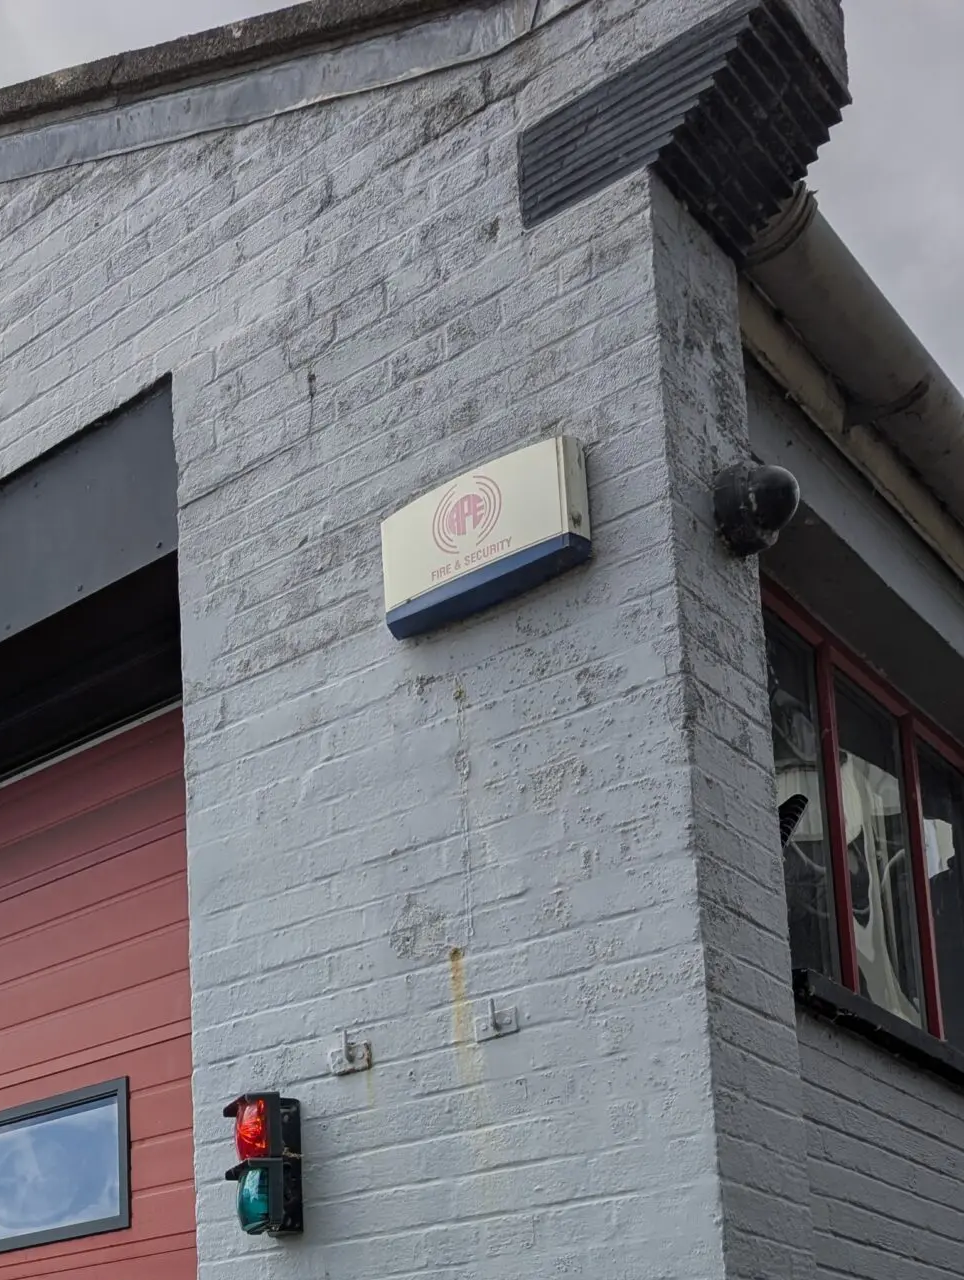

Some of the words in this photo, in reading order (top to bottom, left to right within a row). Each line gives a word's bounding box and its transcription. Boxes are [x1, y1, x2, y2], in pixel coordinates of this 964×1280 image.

[431, 563, 451, 581] FIRE
[454, 559, 462, 572] &
[464, 536, 512, 566] SECURITY
